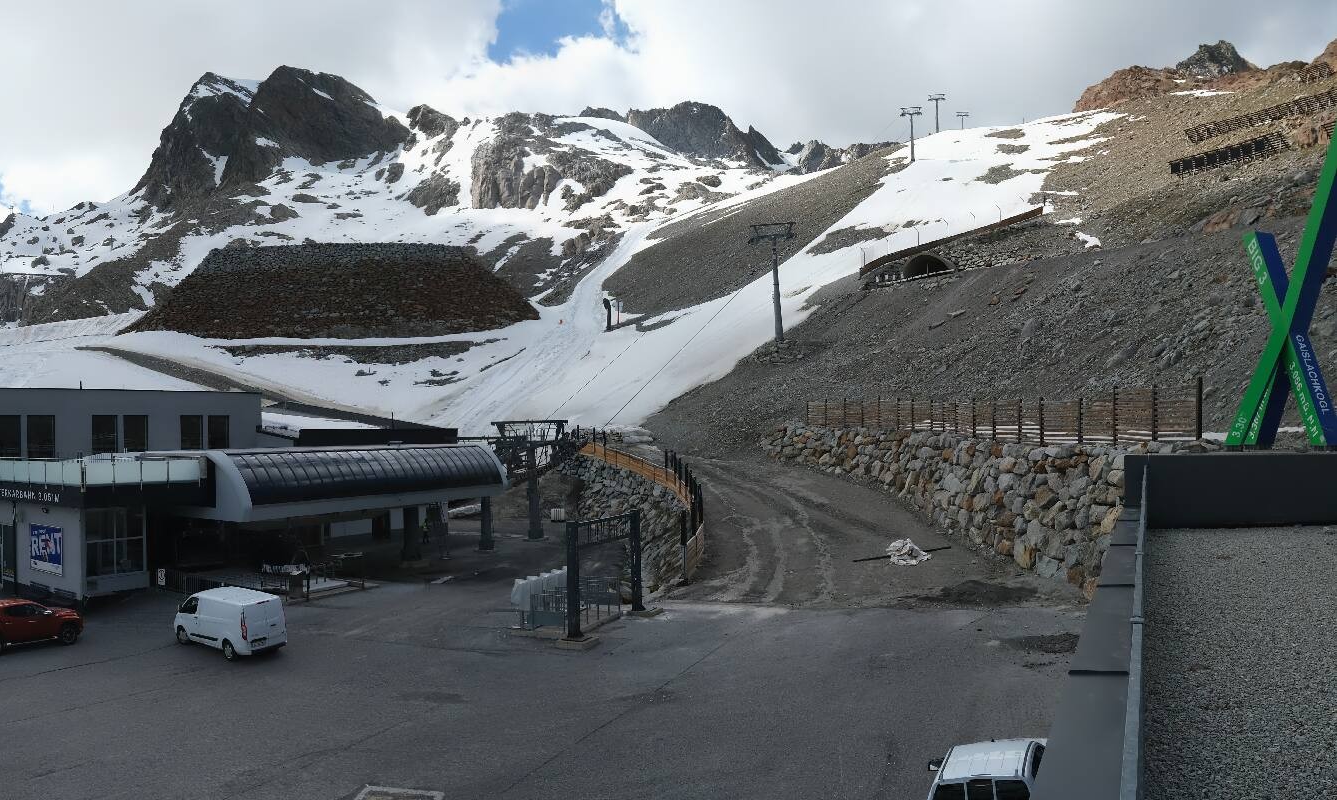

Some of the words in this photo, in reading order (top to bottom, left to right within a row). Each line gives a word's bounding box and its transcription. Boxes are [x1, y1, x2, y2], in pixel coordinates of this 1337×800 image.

[1248, 238, 1263, 272] BIG
[1258, 271, 1268, 285] 3
[1295, 334, 1330, 415] GAISLACHKOGL
